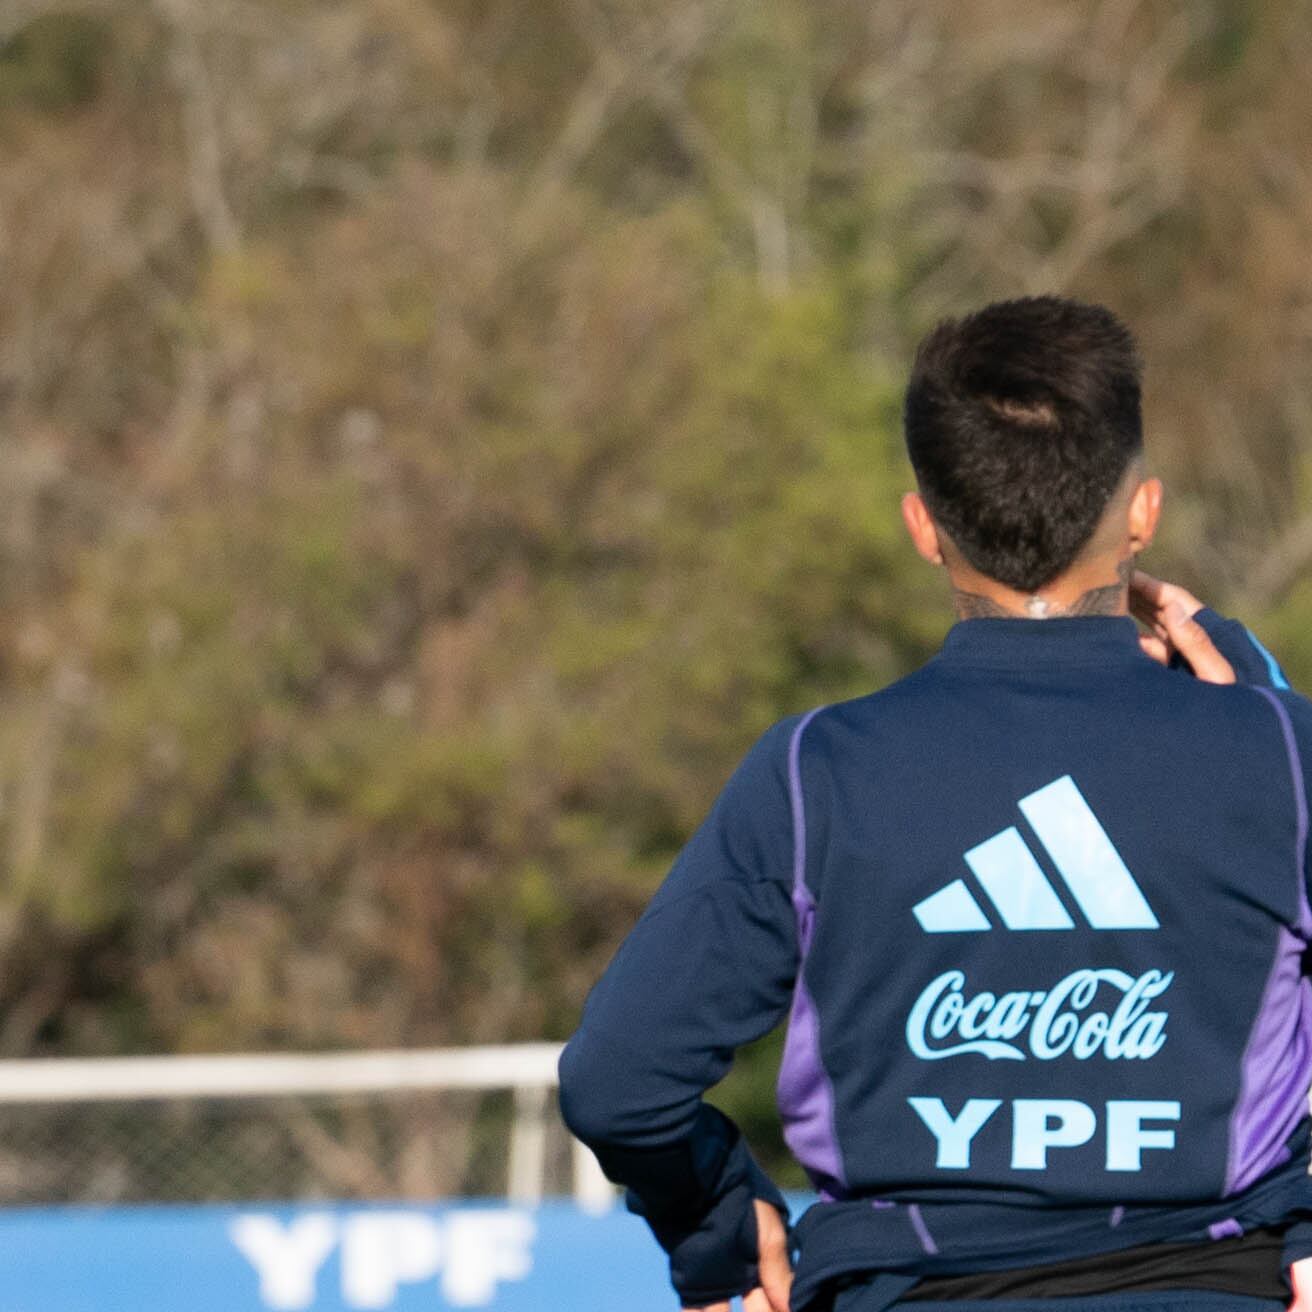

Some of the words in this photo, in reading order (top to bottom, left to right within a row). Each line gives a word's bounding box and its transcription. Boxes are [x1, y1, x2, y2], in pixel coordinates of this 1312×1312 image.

[905, 968, 1174, 1060] Coca-Cola
[907, 1097, 1182, 1171] YPF
[229, 1210, 538, 1310] YPF
